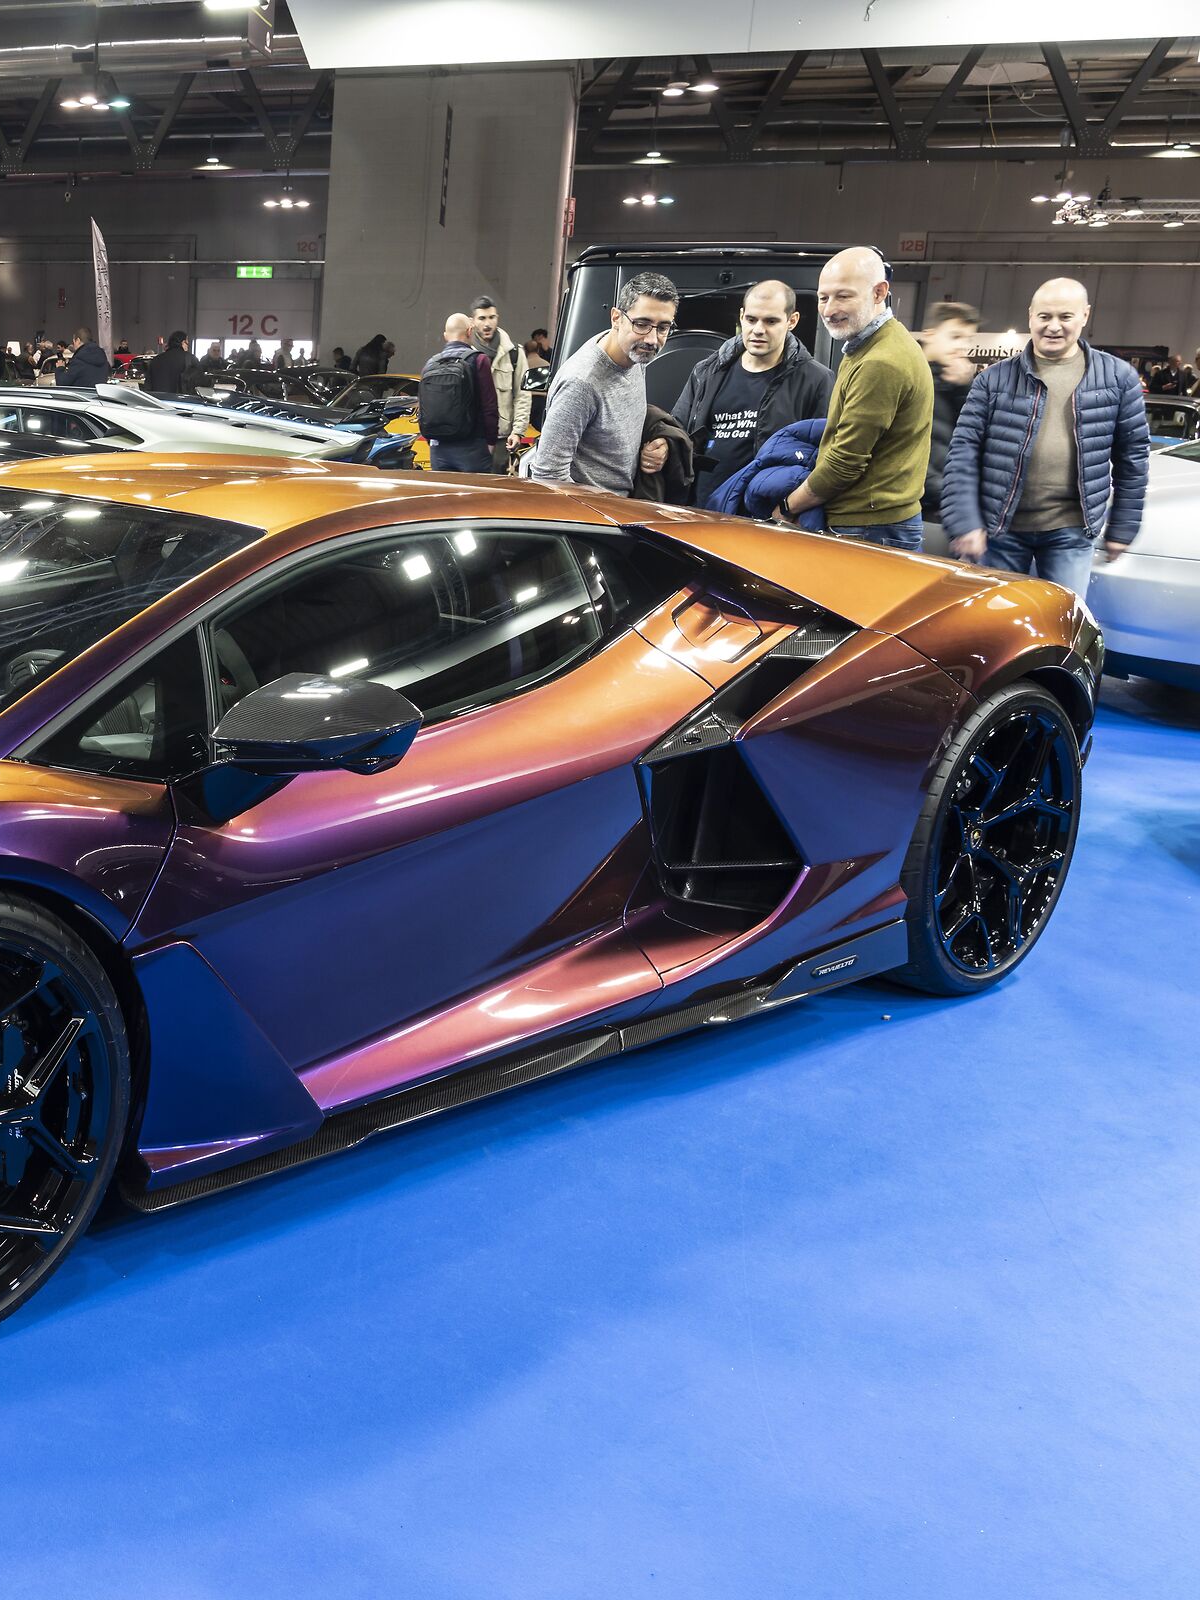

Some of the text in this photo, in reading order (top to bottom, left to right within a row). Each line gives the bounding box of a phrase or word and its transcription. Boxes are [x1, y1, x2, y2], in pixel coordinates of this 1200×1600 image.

[297, 241, 319, 252] 12C
[901, 240, 925, 252] 12B
[228, 314, 279, 336] 12 C
[714, 411, 742, 422] What
[714, 429, 751, 439] You Get
